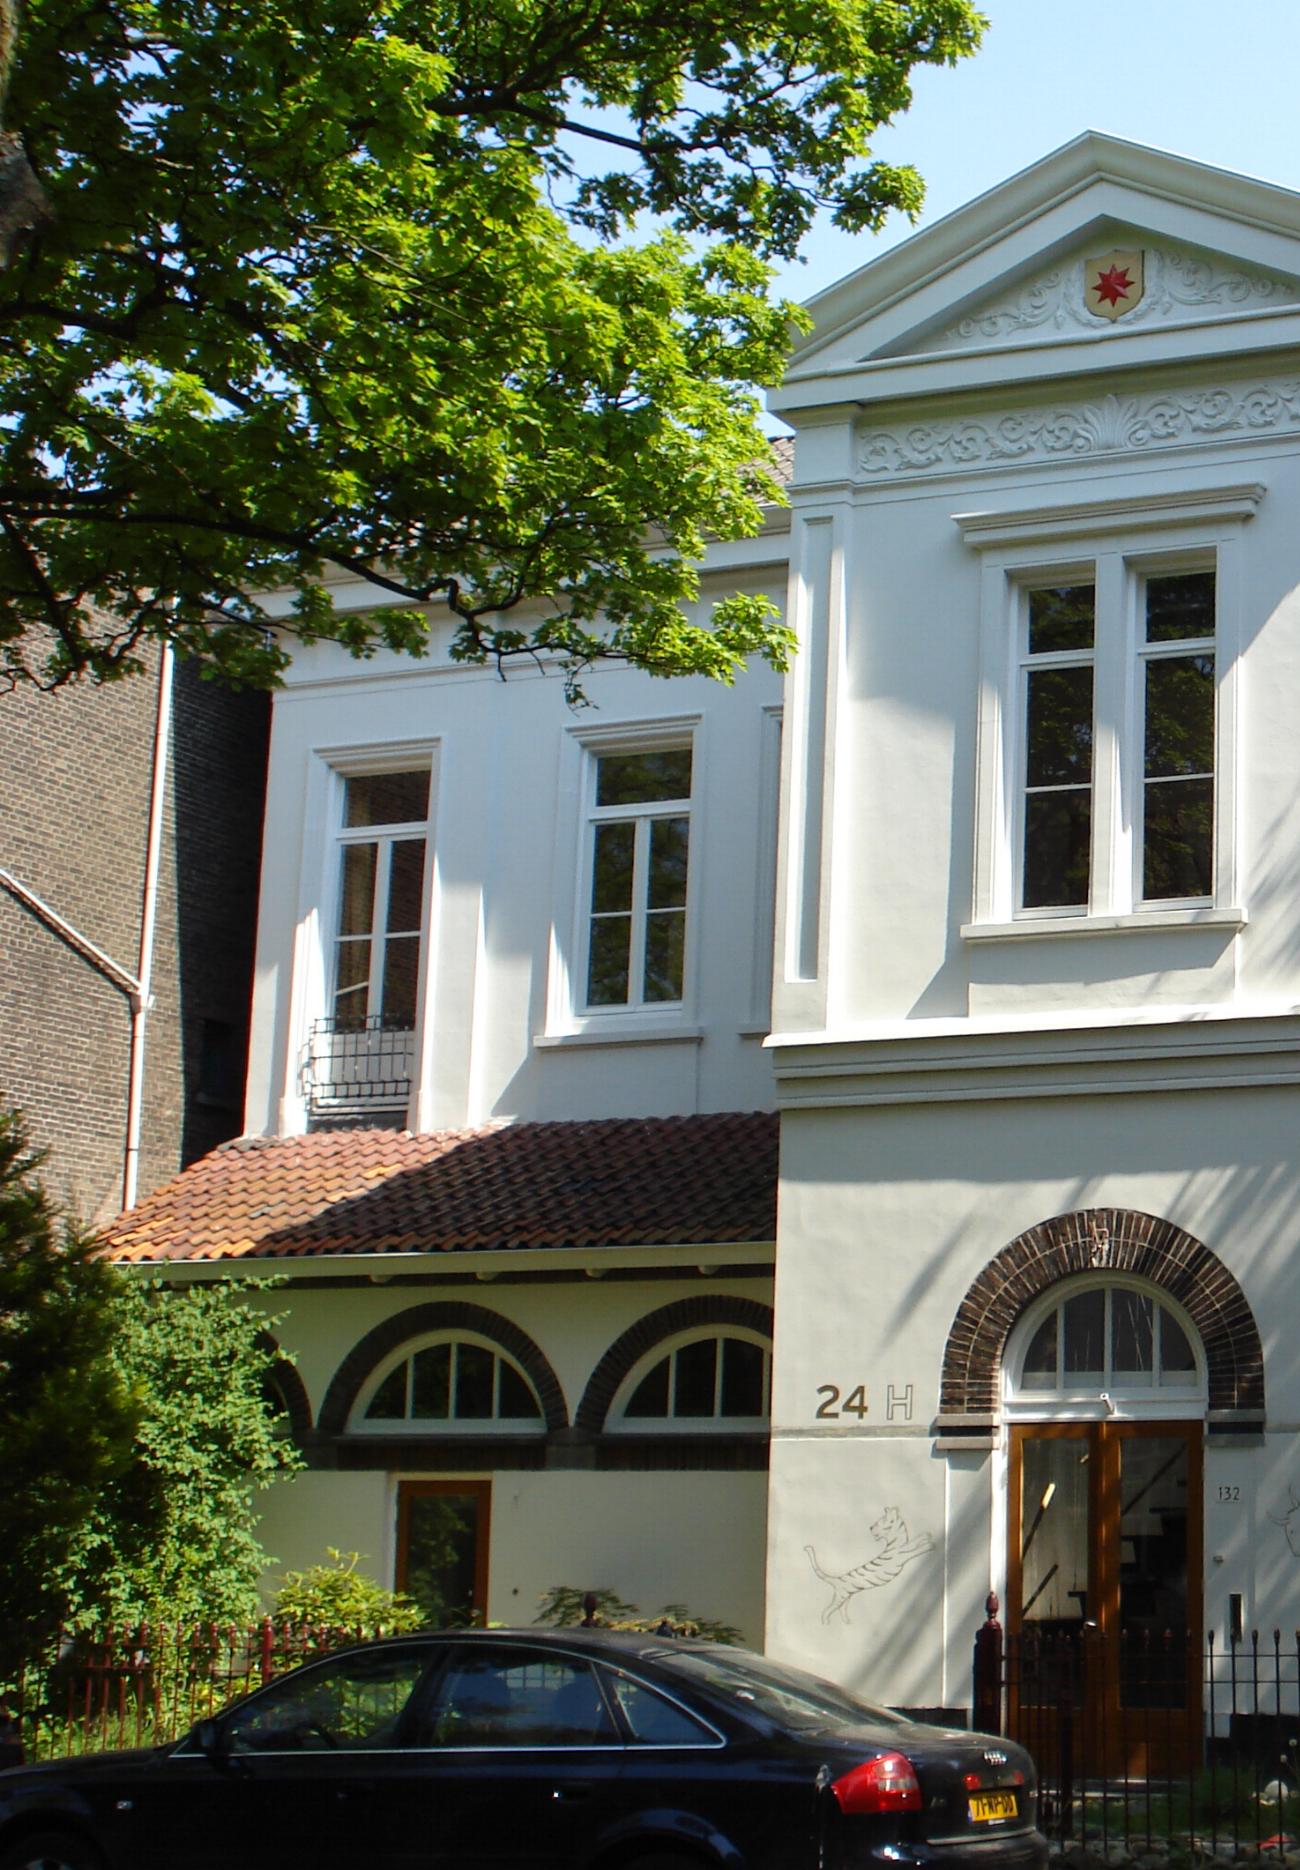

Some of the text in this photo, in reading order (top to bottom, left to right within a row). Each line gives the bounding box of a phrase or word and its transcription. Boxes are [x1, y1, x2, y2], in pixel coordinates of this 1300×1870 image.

[816, 1384, 913, 1421] 24 H
[1218, 1486, 1241, 1501] 132
